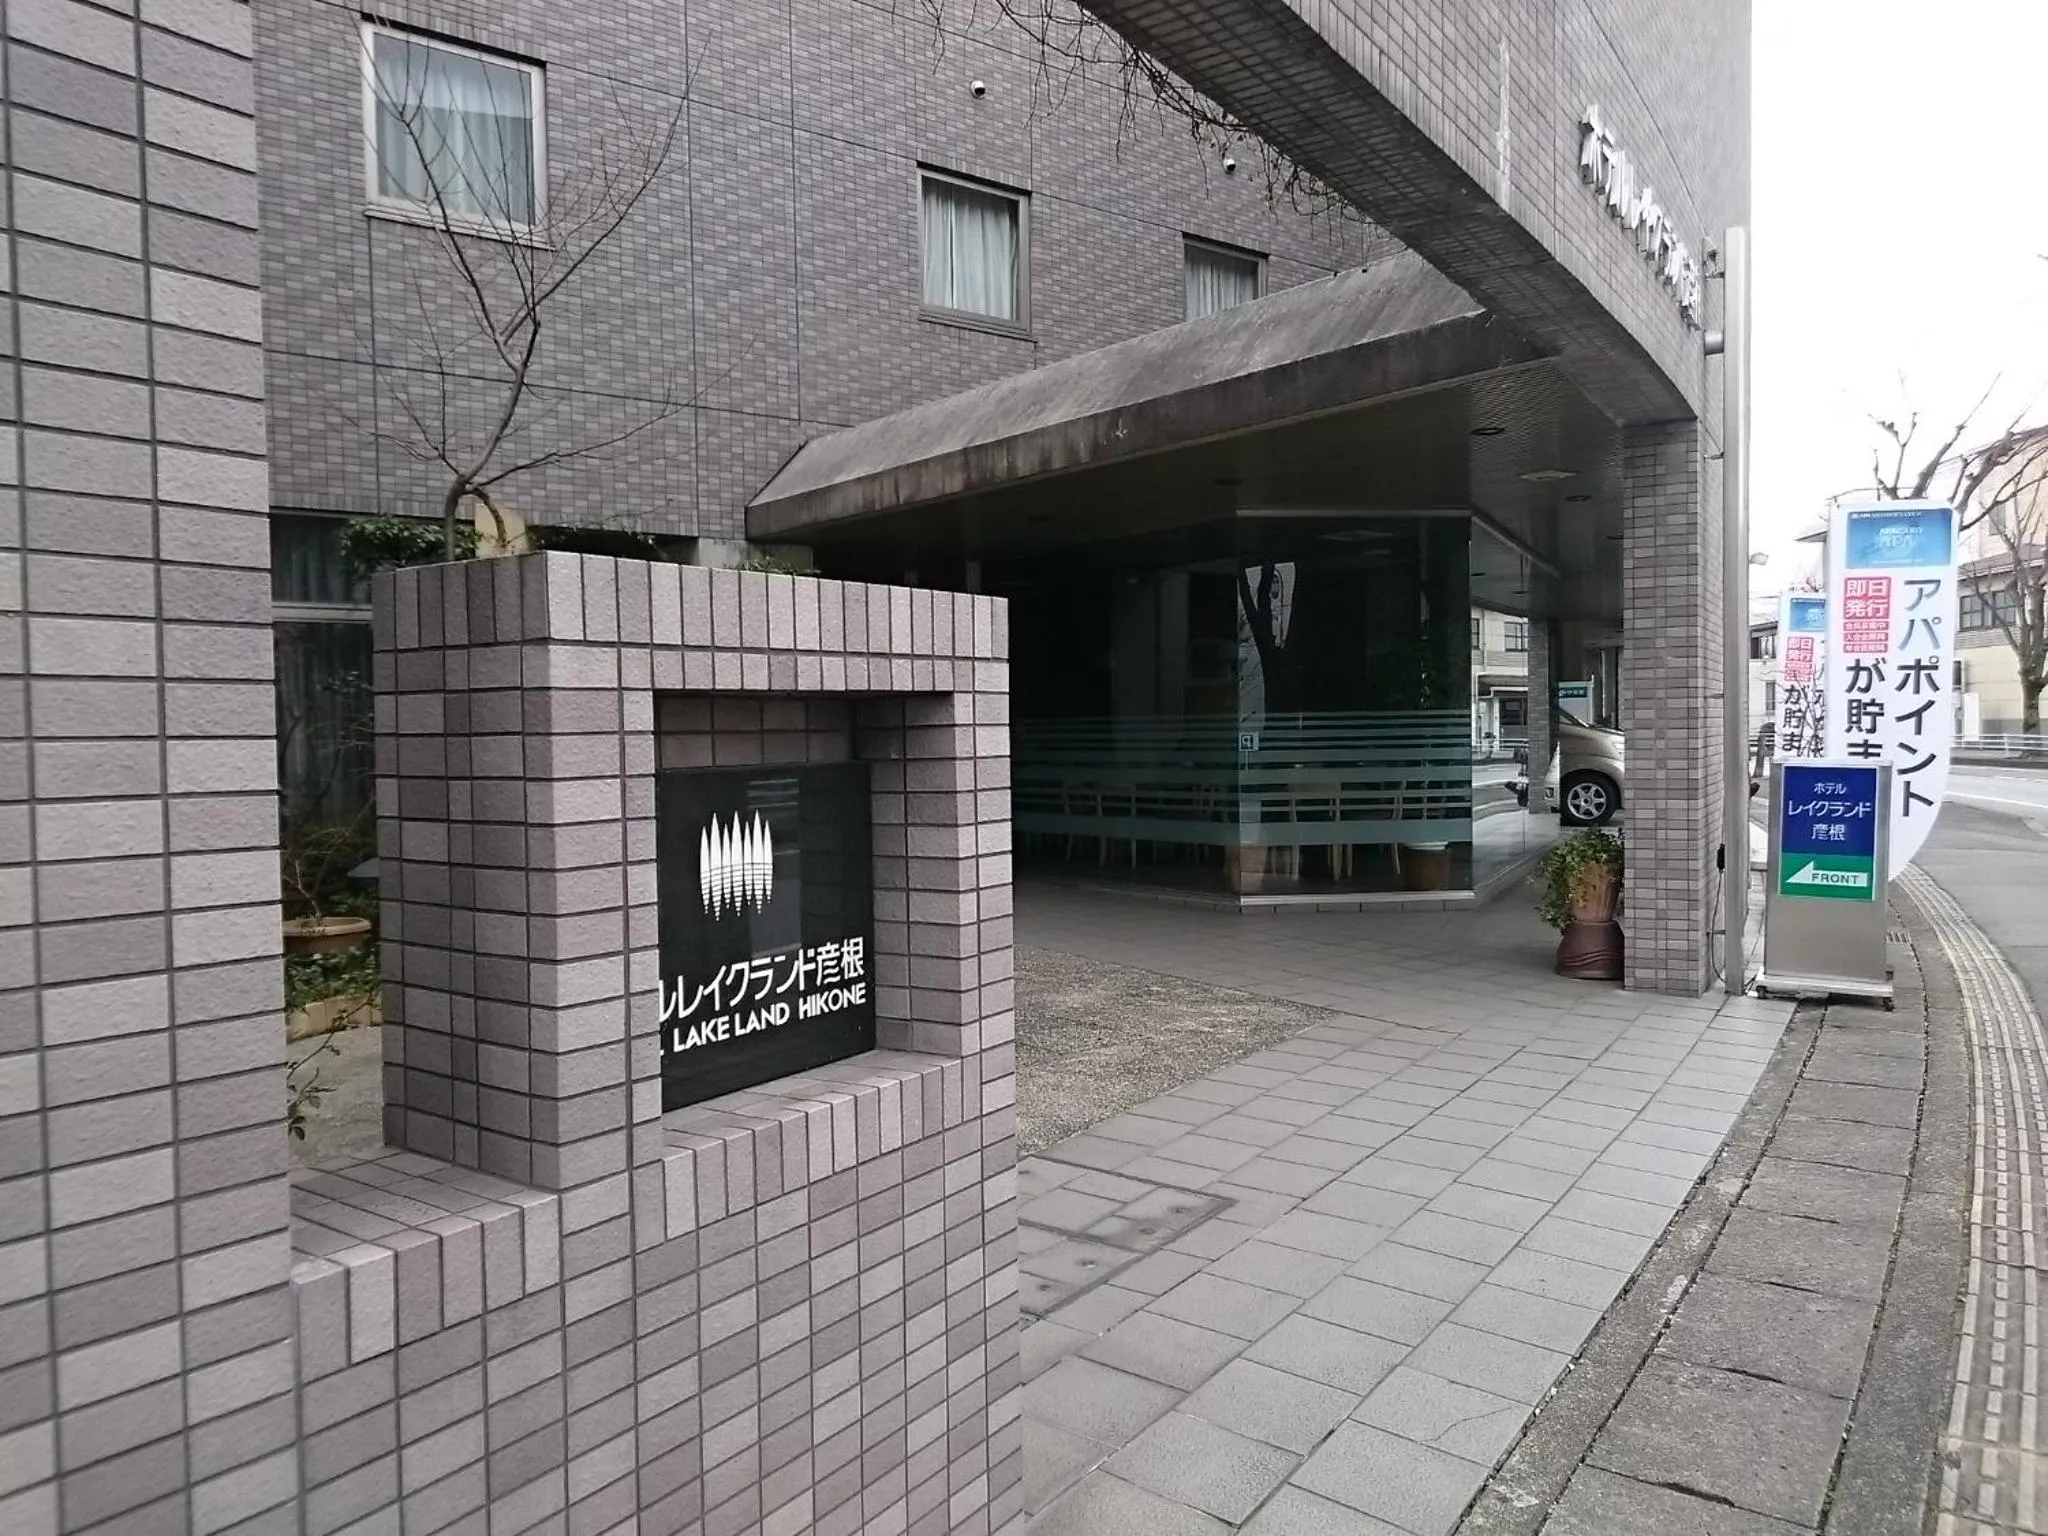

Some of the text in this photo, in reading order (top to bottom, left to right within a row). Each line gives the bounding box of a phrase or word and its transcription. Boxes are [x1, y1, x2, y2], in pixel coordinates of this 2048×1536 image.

[1846, 579, 1888, 597] 即日
[1845, 599, 1889, 617] 発行
[1894, 578, 1942, 818] アパポイント
[1813, 782, 1847, 795] ホテル
[1788, 800, 1872, 818] レイクランド
[1811, 823, 1846, 841] 彦根
[1812, 872, 1859, 885] FRONT
[673, 982, 866, 1053] LAKE LAND HIKONE
